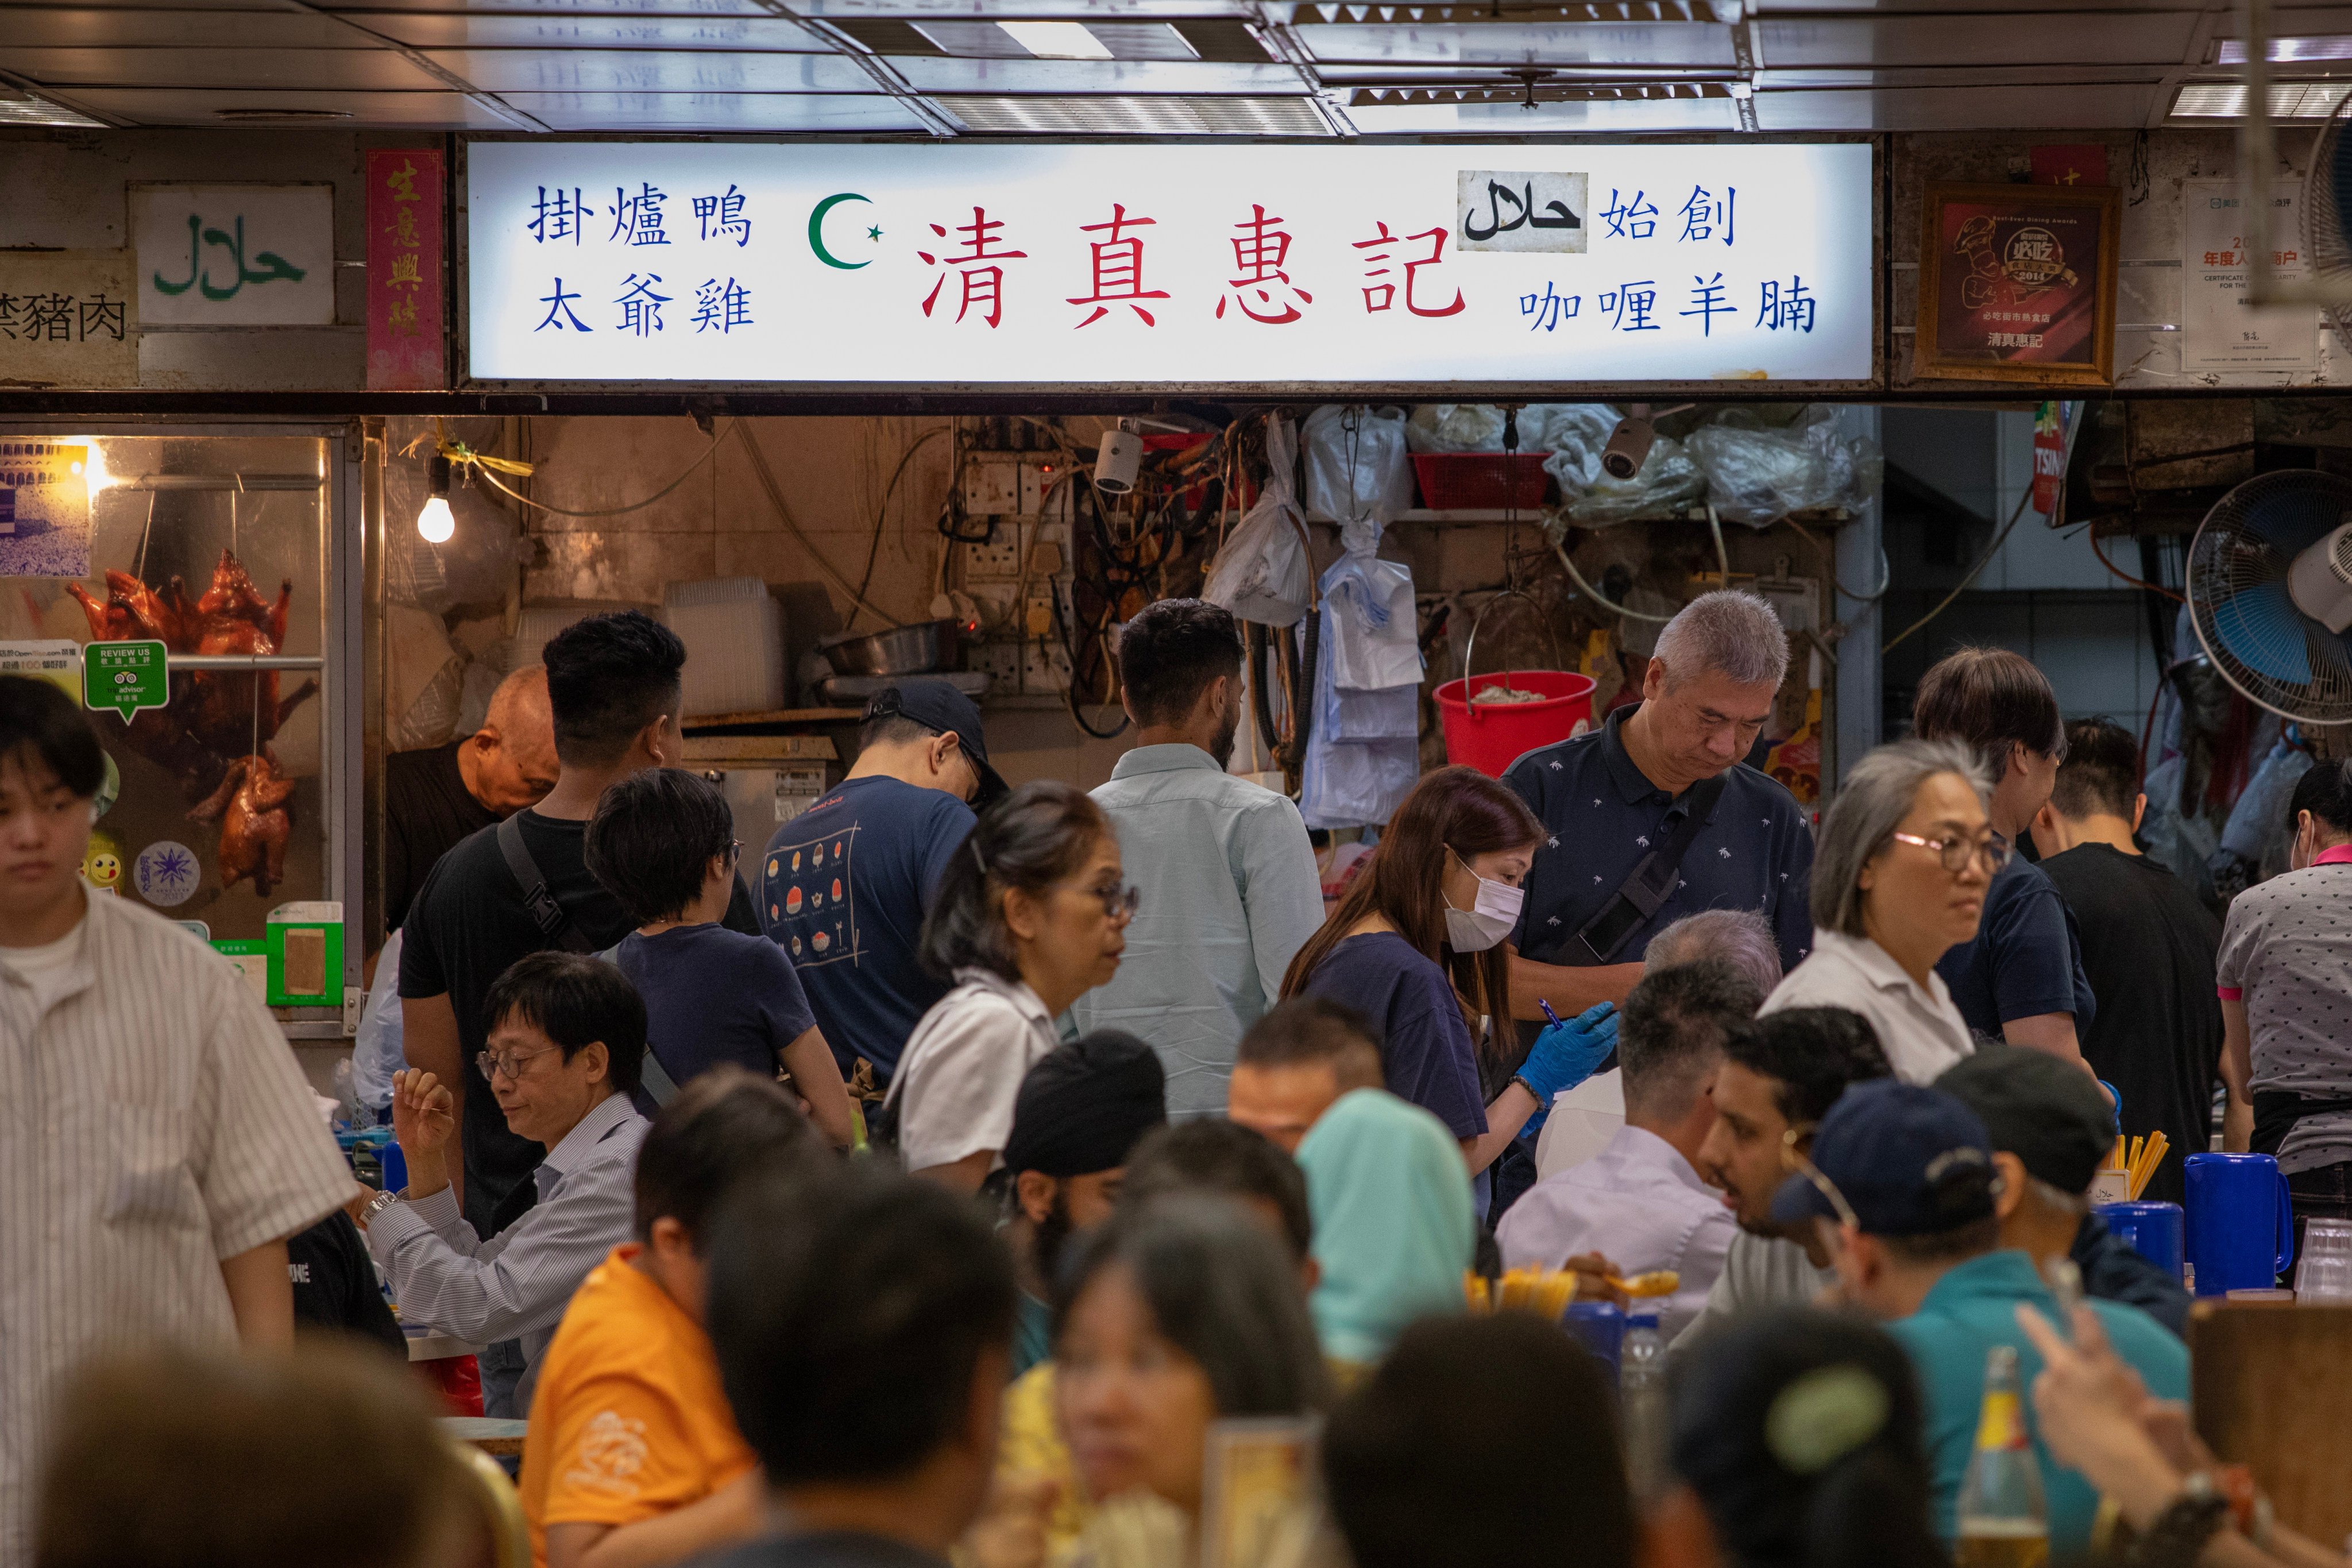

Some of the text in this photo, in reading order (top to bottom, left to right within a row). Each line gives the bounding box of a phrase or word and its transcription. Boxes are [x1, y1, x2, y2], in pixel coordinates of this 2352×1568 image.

[527, 182, 752, 248] 掛爐鴨
[1465, 179, 1581, 241] حلال
[1599, 184, 1736, 246] 始創
[154, 213, 307, 300] حلال
[385, 158, 423, 337] 生意興隆
[917, 203, 1466, 330] 清真惠記
[2012, 241, 2053, 261] 必吃
[2019, 272, 2045, 280] 2014
[2204, 250, 2297, 267] 年度人商户
[534, 273, 754, 338] 太爺雞
[1520, 272, 1816, 338] 咖喱羊腩
[1983, 311, 2051, 323] 必吃街市熟食店
[1987, 332, 2043, 348] 清真惠記
[2036, 446, 2060, 477] TSIN
[101, 649, 135, 657] REVIEW
